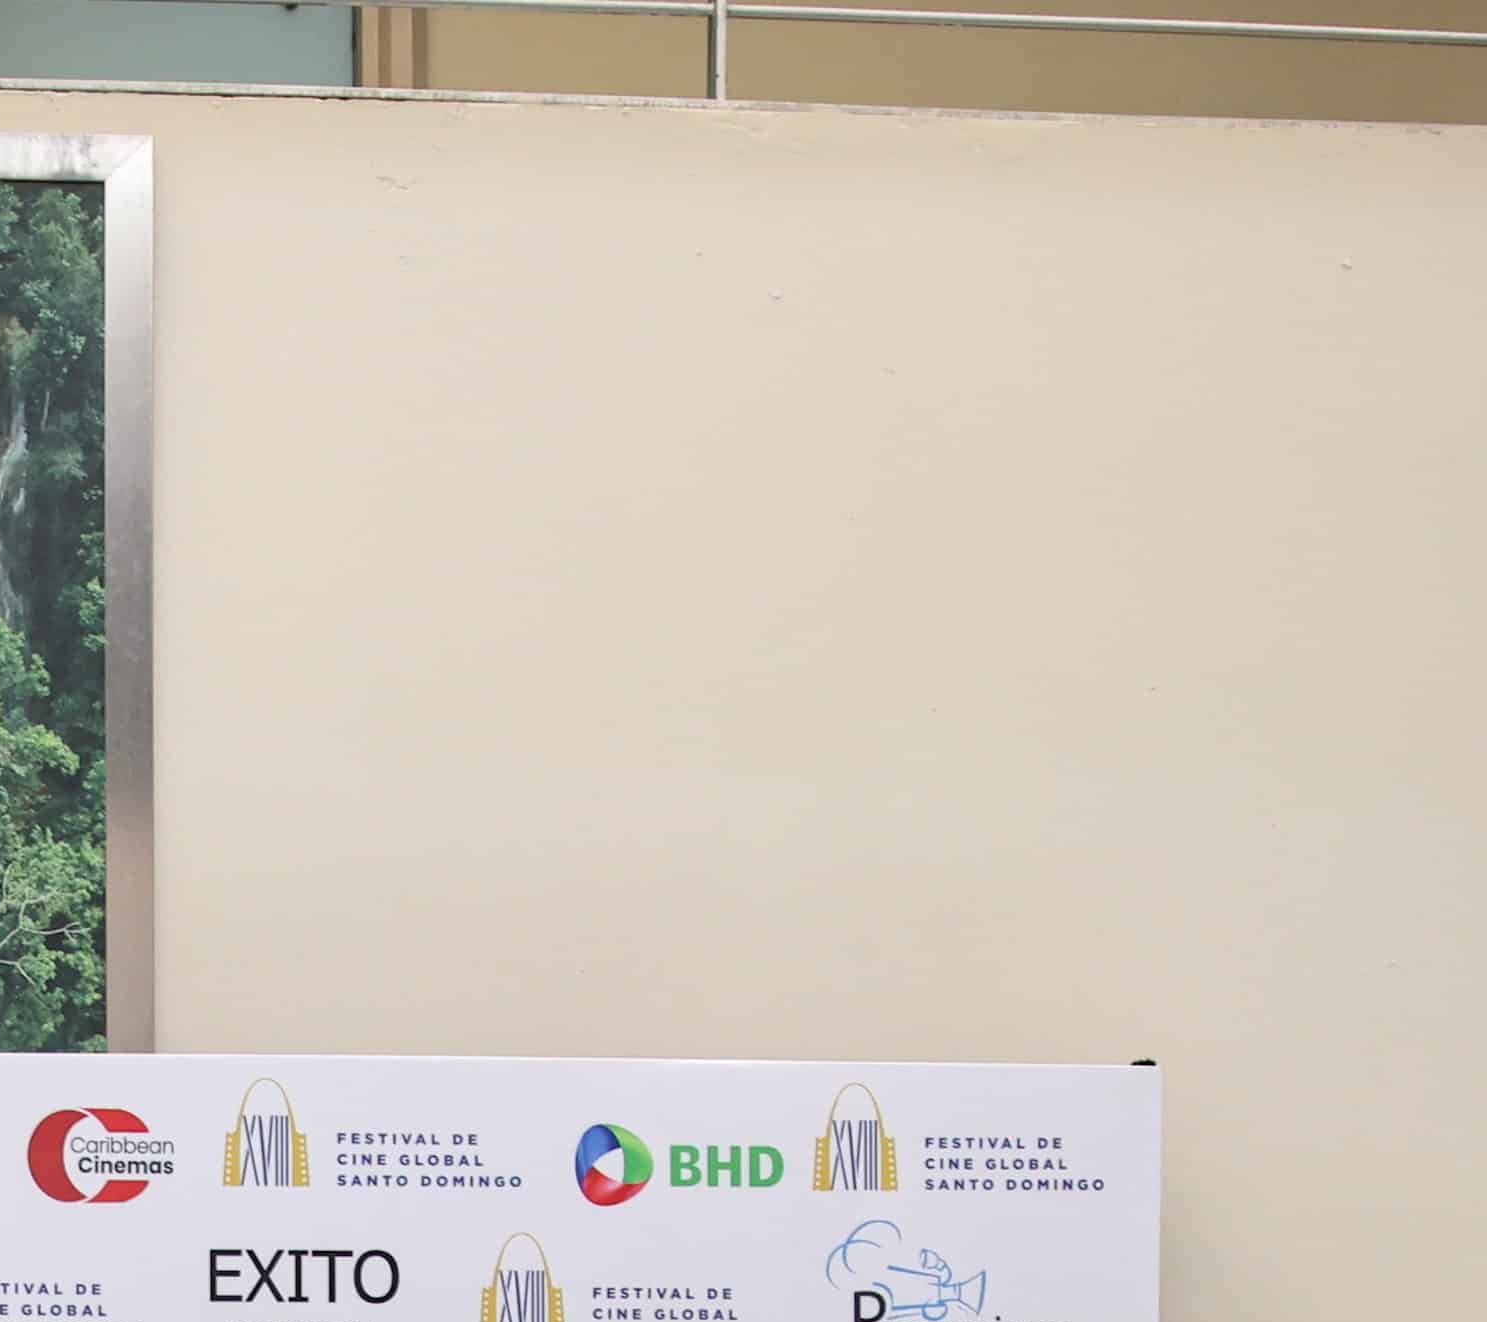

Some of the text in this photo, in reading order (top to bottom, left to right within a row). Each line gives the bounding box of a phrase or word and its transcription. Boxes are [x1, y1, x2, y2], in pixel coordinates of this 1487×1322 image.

[70, 1136, 175, 1154] Caribbean
[336, 1132, 478, 1146] FESTIVAL DE
[924, 1136, 1062, 1150] FESTIVAL DE
[78, 1156, 174, 1174] Cinemas
[336, 1153, 484, 1167] CINE GLOBAL
[670, 1144, 784, 1187] BHD
[924, 1157, 1068, 1171] CINE GLOBAL
[337, 1174, 522, 1188] SANTO DOMINGO
[925, 1178, 1105, 1191] SANTO DOMINGO
[209, 1249, 400, 1304] EXITO
[592, 1287, 732, 1300] FESTIVAL DE
[592, 1307, 738, 1321] CINE GLOBAL
